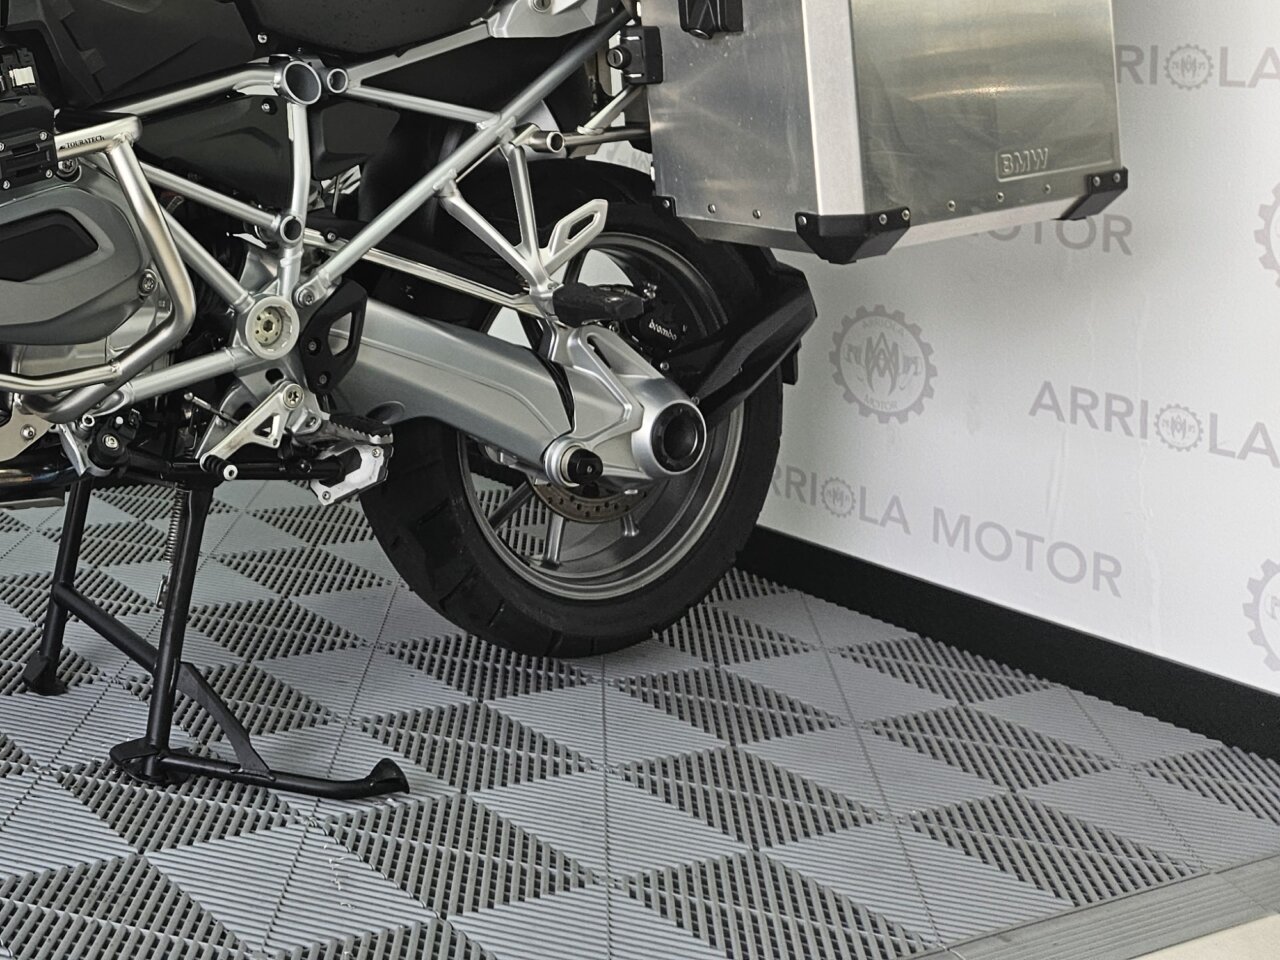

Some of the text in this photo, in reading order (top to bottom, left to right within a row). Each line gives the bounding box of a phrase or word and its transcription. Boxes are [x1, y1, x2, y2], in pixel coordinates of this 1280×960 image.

[1000, 147, 1050, 174] BMW
[648, 318, 678, 341] brembo
[932, 507, 1122, 598] MOTOR
